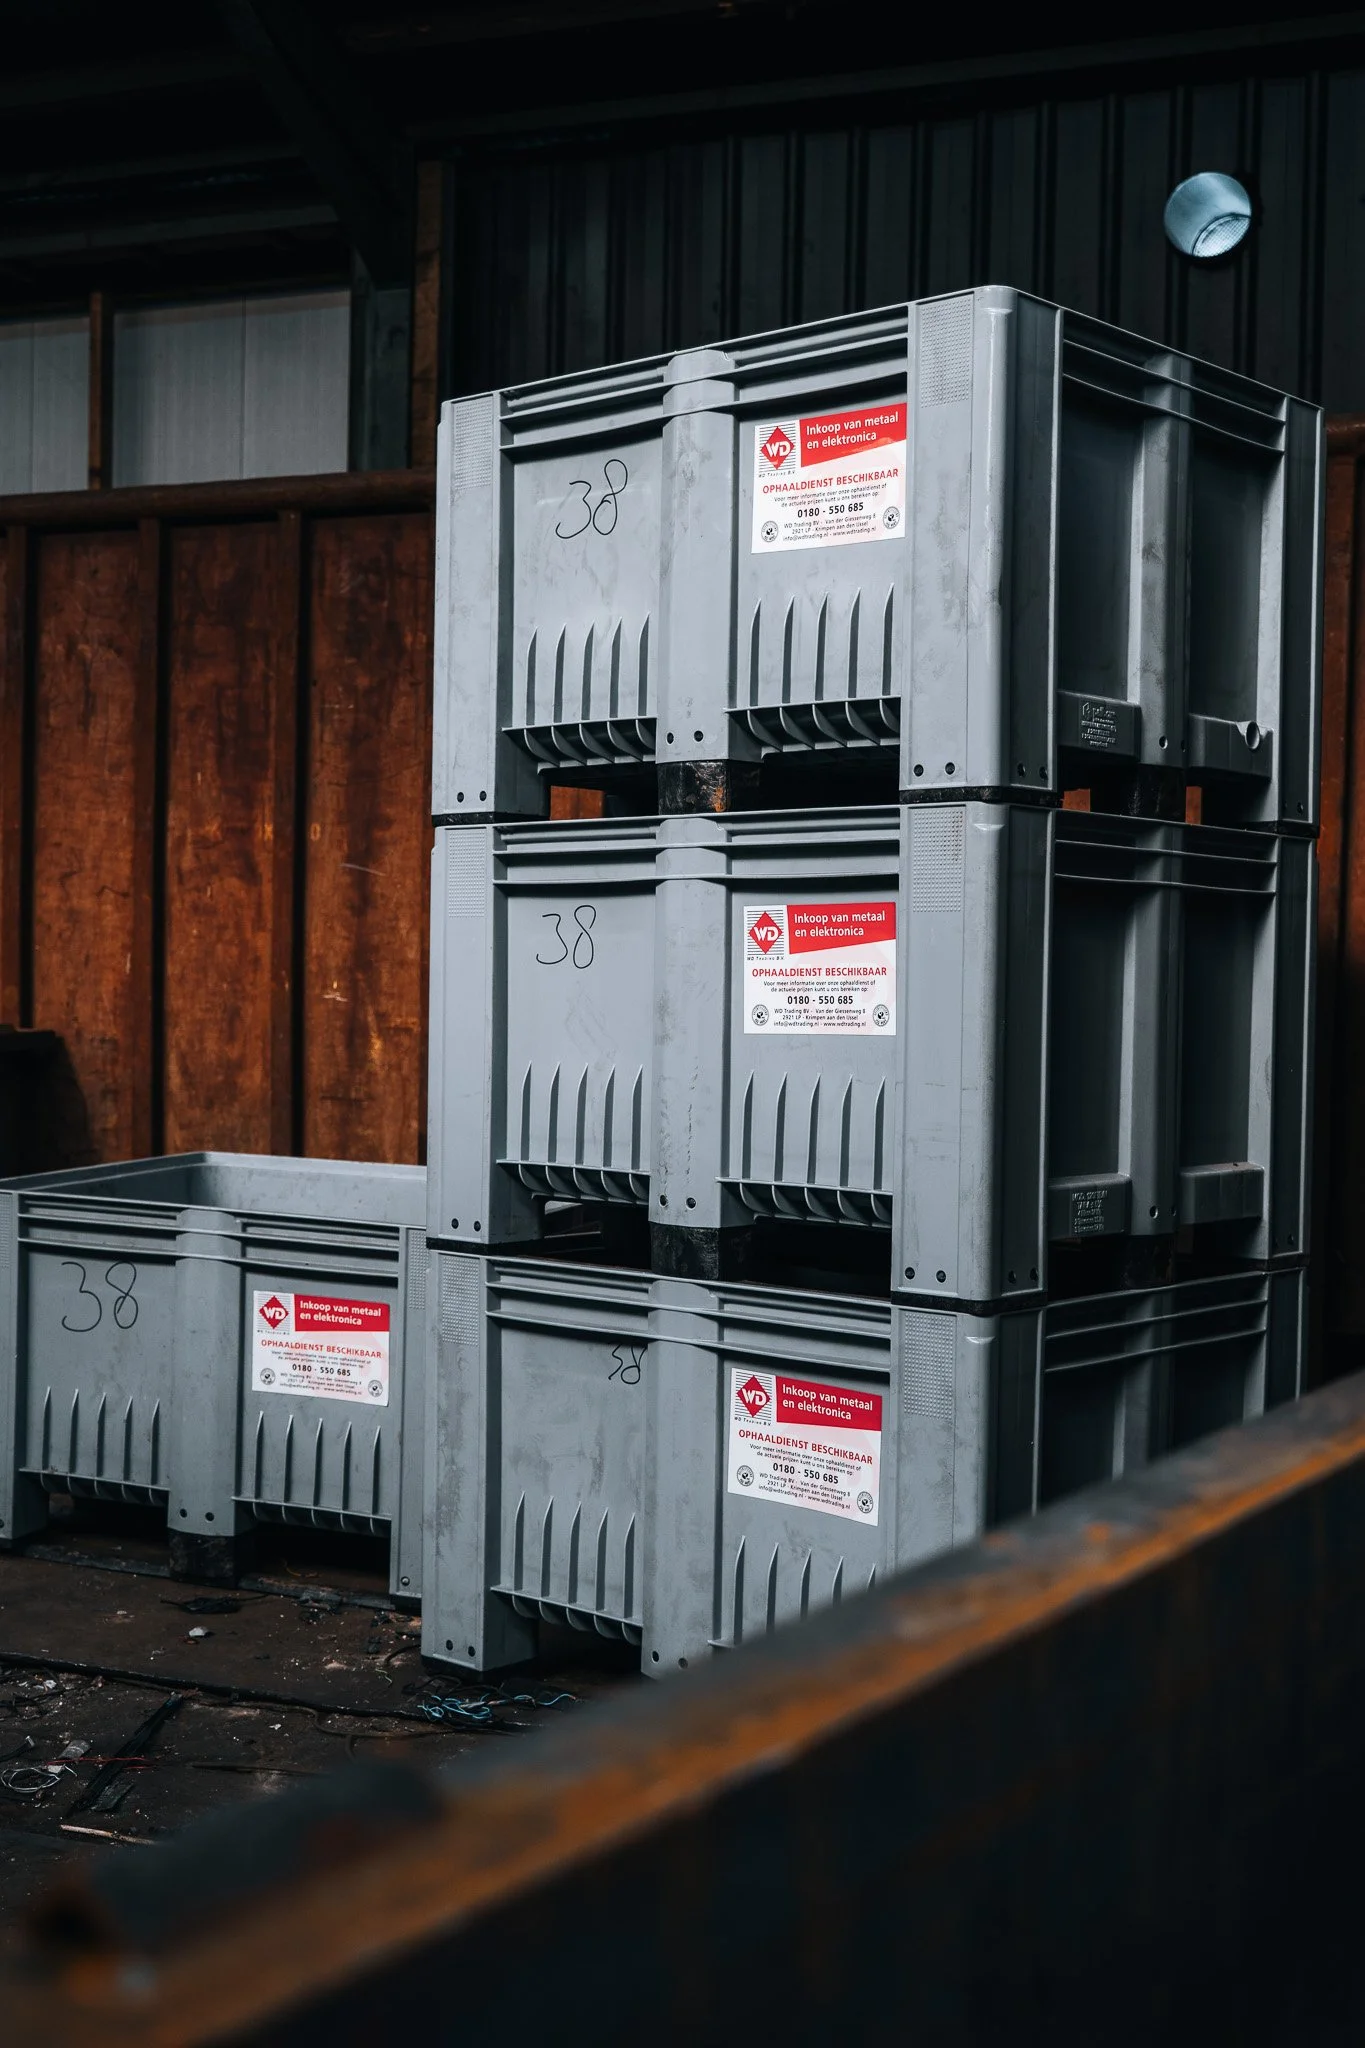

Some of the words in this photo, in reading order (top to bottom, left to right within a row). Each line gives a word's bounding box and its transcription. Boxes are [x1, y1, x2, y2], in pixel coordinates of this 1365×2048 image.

[807, 424, 840, 435] Inkoop
[844, 420, 861, 430] van
[865, 412, 898, 426] metaal
[807, 441, 819, 449] en
[822, 431, 876, 447] elektronica
[766, 441, 790, 458] WD
[763, 478, 833, 493] OPHAALDIENST
[837, 469, 898, 485] BESCHIKBAAR
[555, 458, 628, 539] 38
[798, 508, 820, 518] 0180
[829, 504, 845, 514] 550
[848, 502, 863, 512] 685
[794, 913, 828, 925] Inkoop
[852, 911, 885, 921] metaal
[536, 904, 597, 969] 38
[754, 926, 778, 941] WD
[810, 926, 864, 936] elektronica
[752, 968, 822, 977] OPHAALDIENST
[826, 967, 886, 976] BESCHIKBAAR
[787, 996, 810, 1004] 0180
[819, 996, 834, 1004] 550
[838, 996, 853, 1004] 685
[60, 1260, 139, 1333] 38
[263, 1306, 286, 1320] WD
[300, 1301, 331, 1312] Inkoop
[351, 1307, 381, 1316] metaal
[314, 1313, 362, 1325] elektronica
[262, 1340, 323, 1351] OPHAALDIENST
[327, 1346, 381, 1358] BESCHIKBAAR
[292, 1364, 312, 1372] 0180
[742, 1388, 766, 1406] WD
[783, 1384, 816, 1401] Inkoop
[819, 1393, 836, 1403] van
[840, 1397, 872, 1410] metaal
[783, 1400, 794, 1408] en
[798, 1401, 851, 1420] elektronica
[739, 1430, 808, 1449] OPHAALDIENST
[812, 1443, 872, 1464] BESCHIKBAAR
[773, 1463, 795, 1474] 0180
[804, 1469, 820, 1480] 550
[823, 1473, 838, 1484] 685
